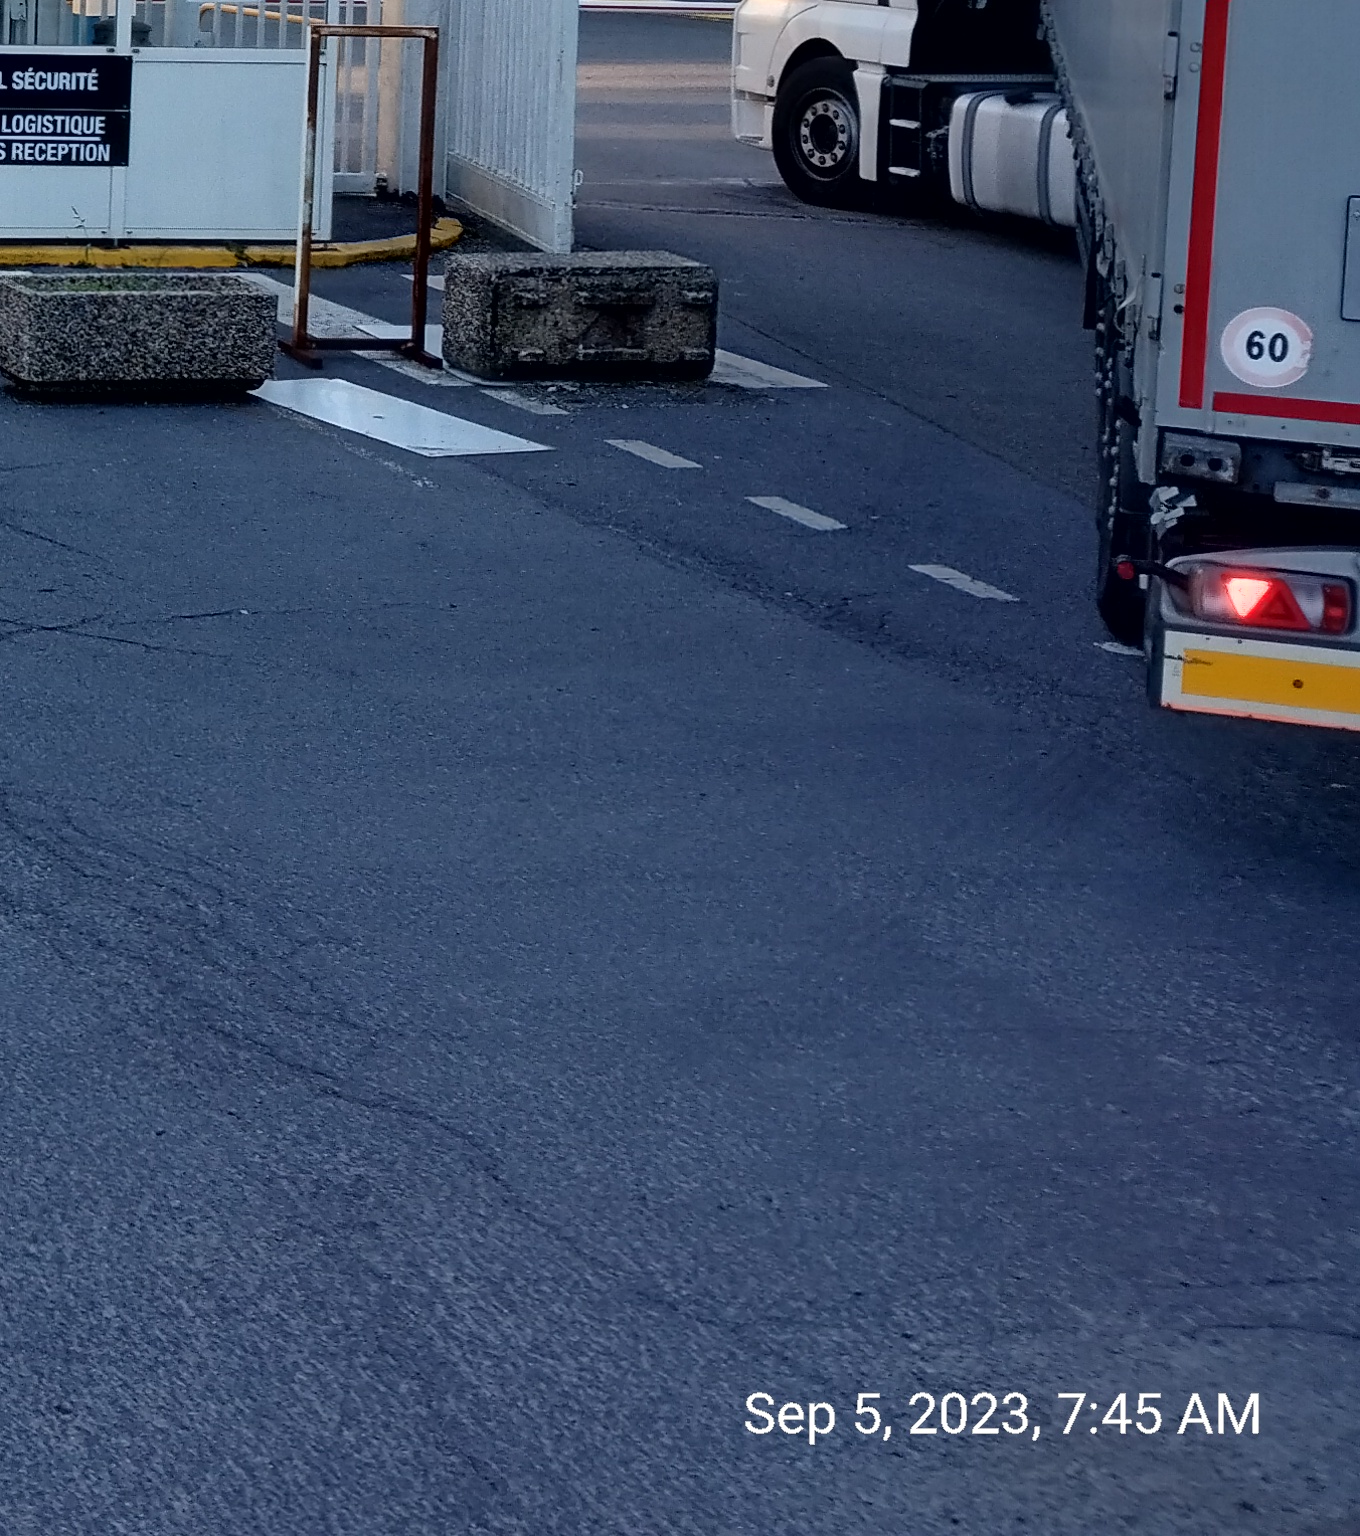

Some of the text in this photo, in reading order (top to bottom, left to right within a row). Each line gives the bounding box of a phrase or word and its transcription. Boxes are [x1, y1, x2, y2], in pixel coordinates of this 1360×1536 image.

[11, 67, 99, 91] SÉCURITÉ
[0, 114, 107, 135] LOGISTIQUE
[10, 142, 111, 162] RECEPTION
[1245, 330, 1289, 363] 60
